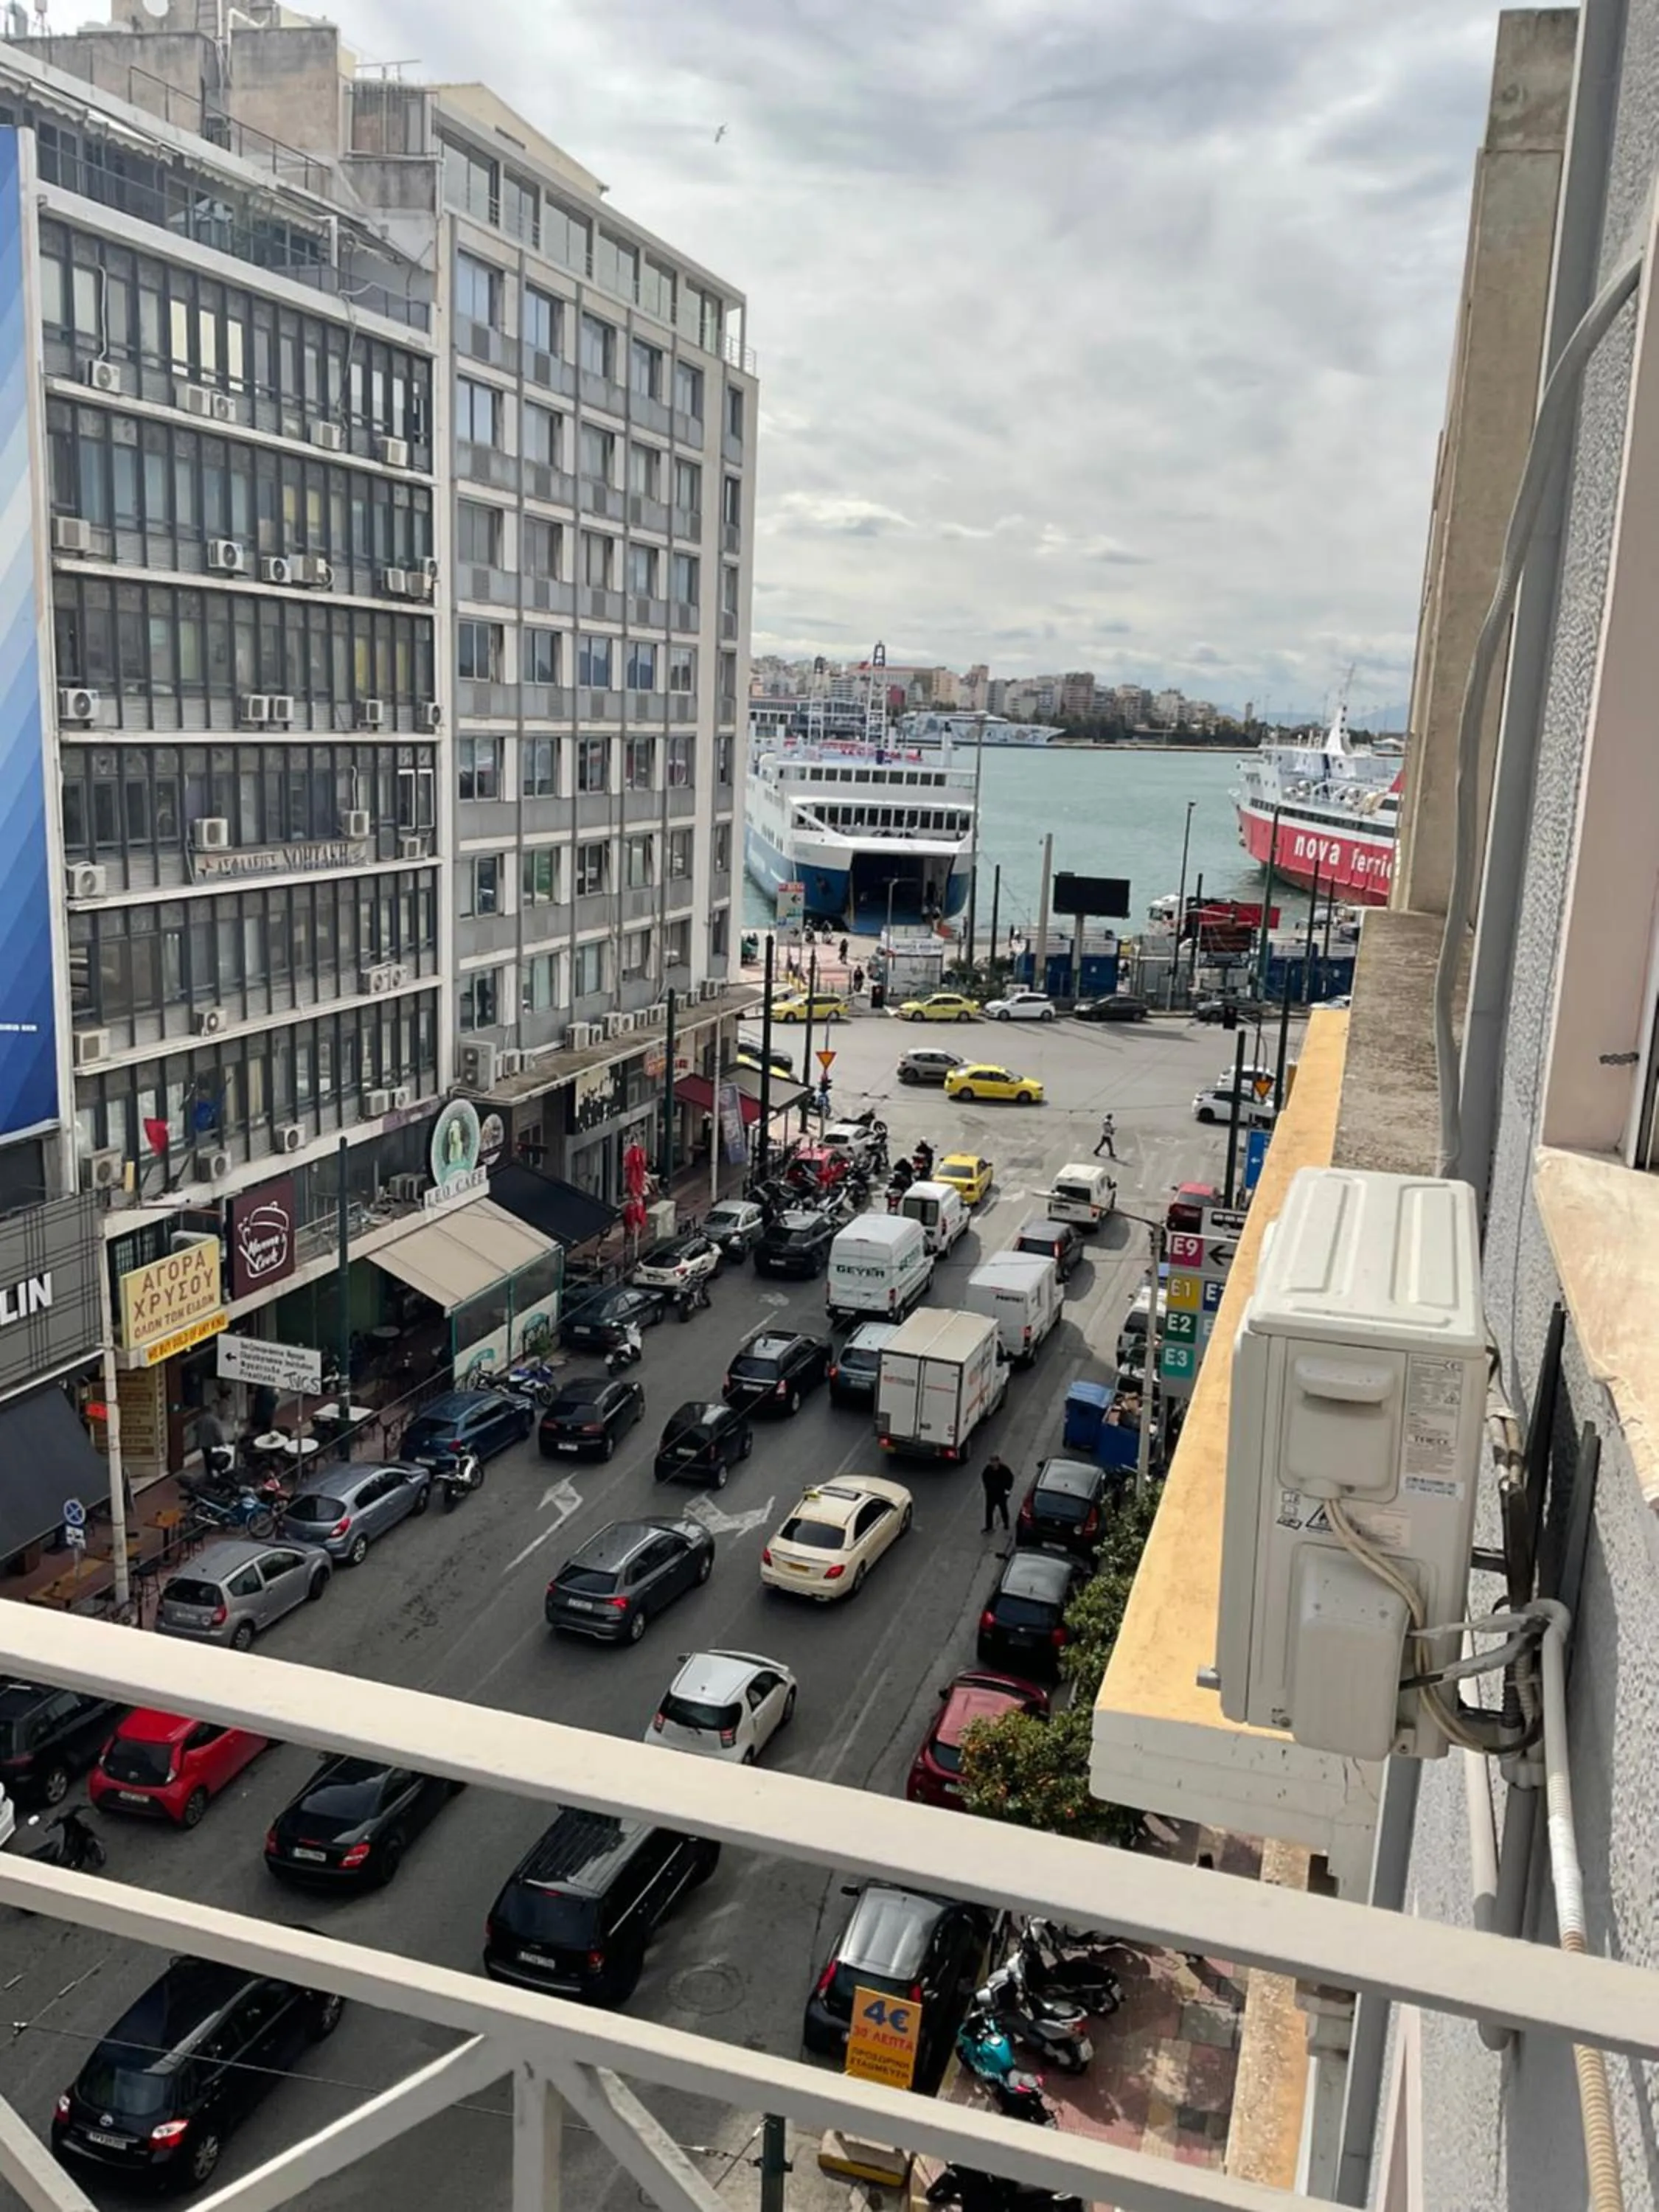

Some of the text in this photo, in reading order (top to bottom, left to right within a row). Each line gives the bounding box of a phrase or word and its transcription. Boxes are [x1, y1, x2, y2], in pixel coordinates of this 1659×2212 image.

[1294, 835, 1340, 866] nova
[1172, 1237, 1199, 1256] E9
[142, 1250, 206, 1293] ΑΓΟΡΑ
[133, 1267, 214, 1321] ΧΡΥΣΟΥ
[1170, 1279, 1191, 1298] E1
[1167, 1312, 1192, 1333] E2
[1164, 1347, 1188, 1367] E3
[863, 2000, 910, 2033] 4€
